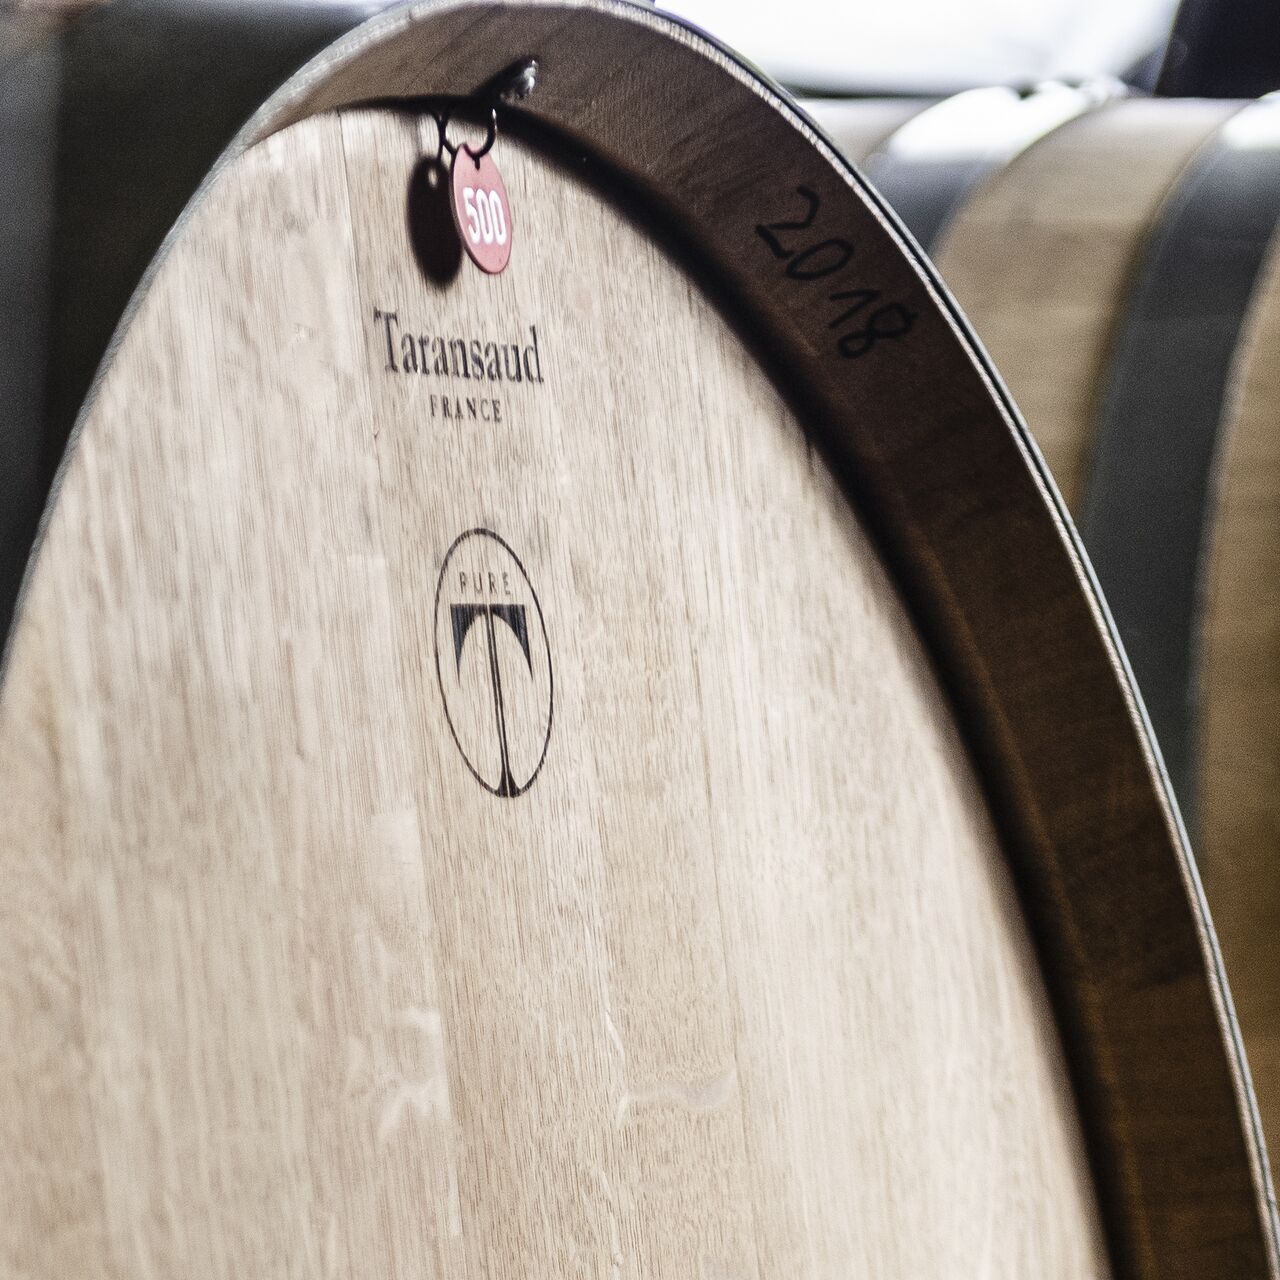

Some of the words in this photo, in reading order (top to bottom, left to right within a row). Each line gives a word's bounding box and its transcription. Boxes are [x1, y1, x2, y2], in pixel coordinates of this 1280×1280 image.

[462, 187, 507, 244] 500
[756, 186, 916, 357] 2018
[374, 308, 543, 385] Taransaud
[429, 394, 502, 422] FRANCE
[458, 571, 512, 595] PURE
